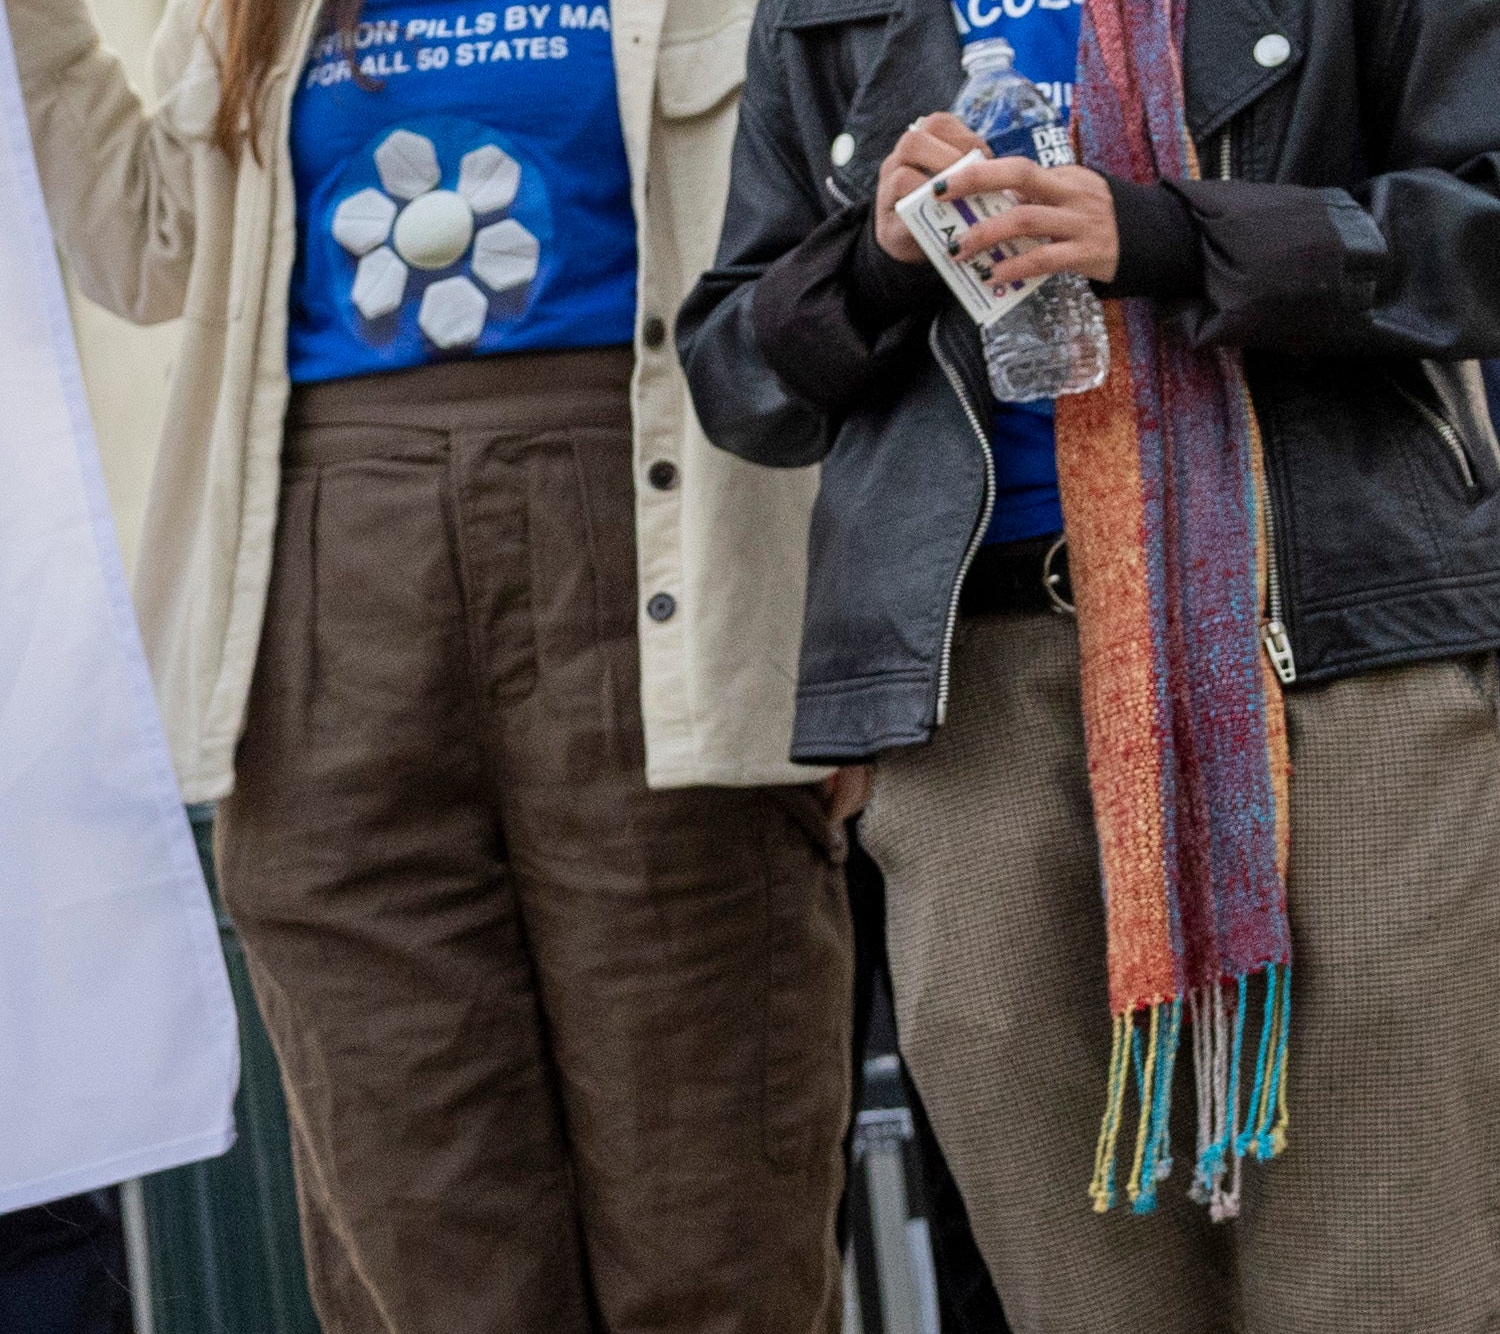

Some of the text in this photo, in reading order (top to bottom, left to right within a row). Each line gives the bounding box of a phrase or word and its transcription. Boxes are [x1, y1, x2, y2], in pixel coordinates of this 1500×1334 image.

[406, 12, 497, 40] PILLS
[504, 4, 551, 32] BY
[359, 52, 412, 77] ALL
[416, 46, 449, 71] 50
[455, 36, 569, 67] STATES
